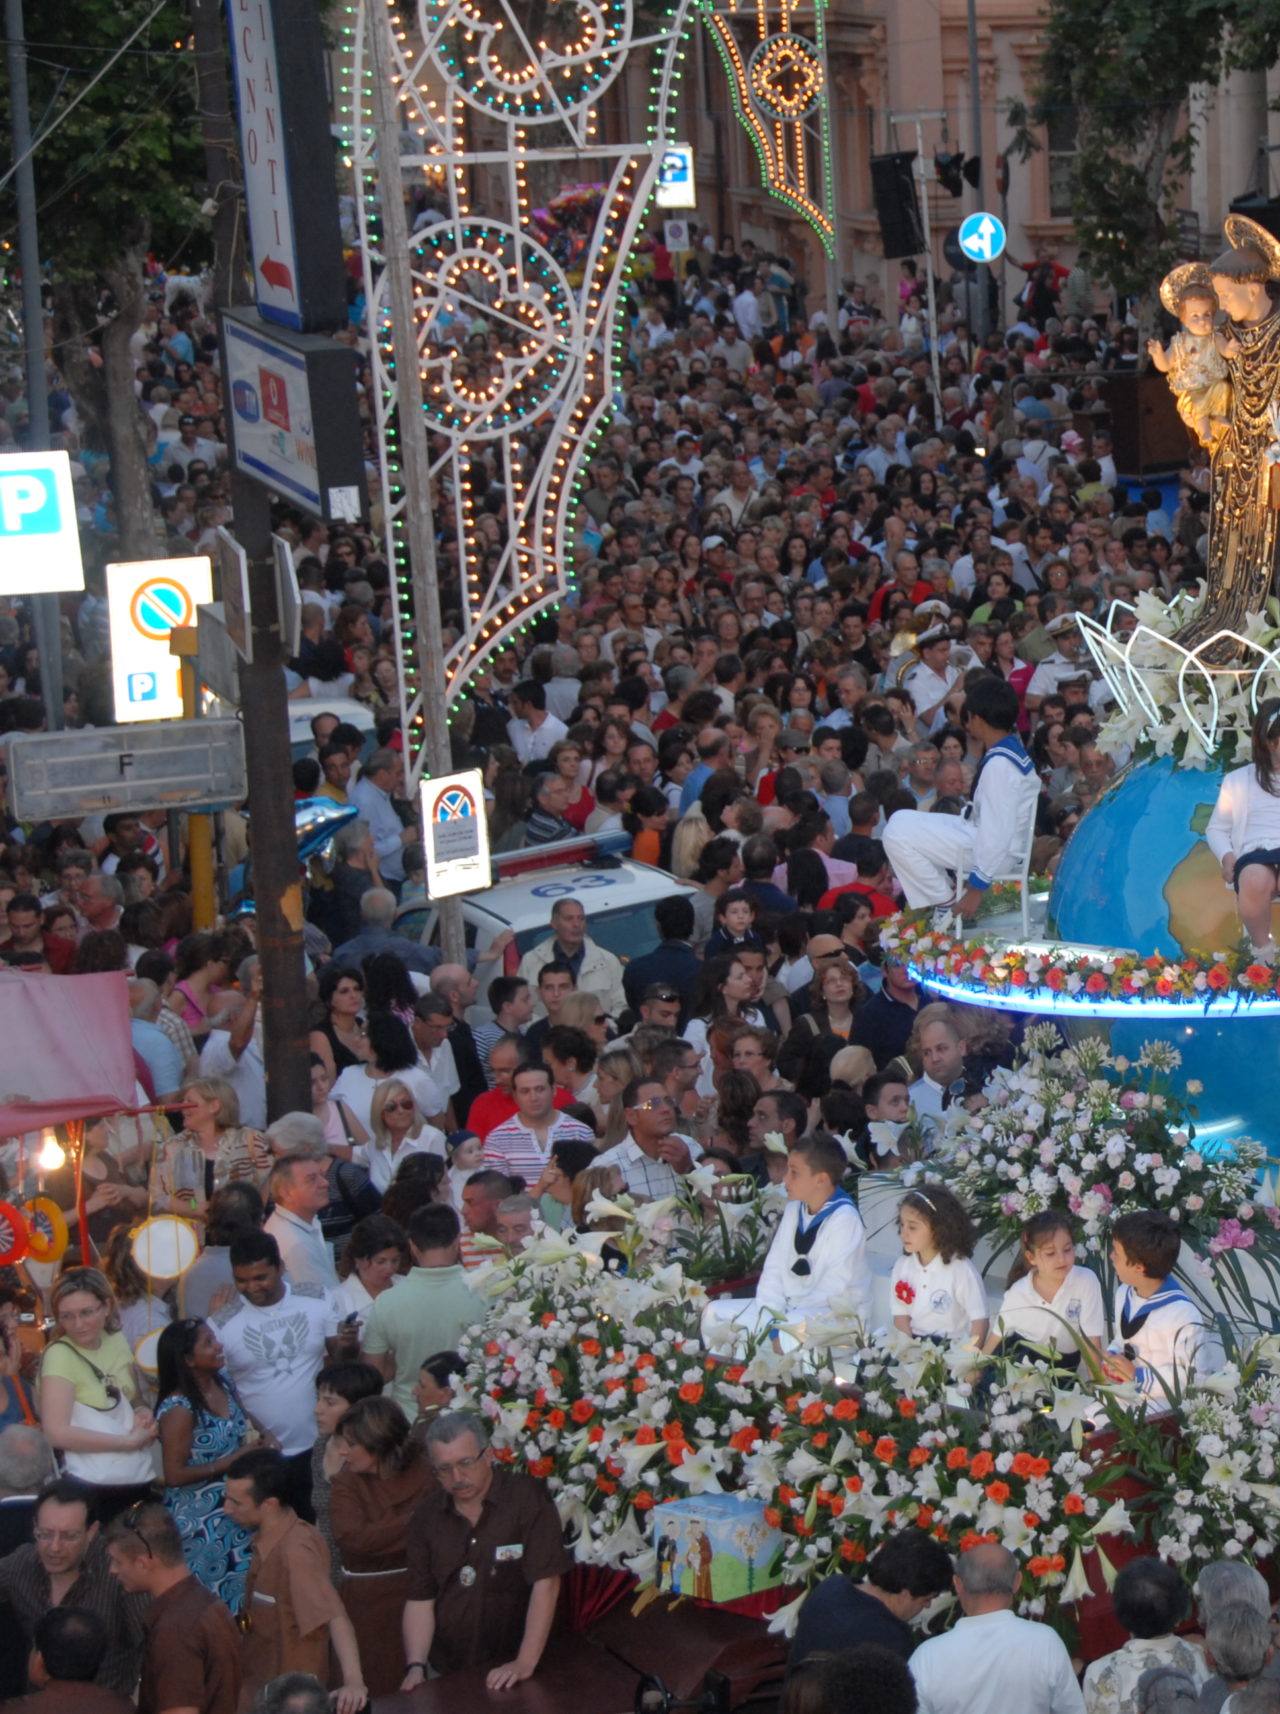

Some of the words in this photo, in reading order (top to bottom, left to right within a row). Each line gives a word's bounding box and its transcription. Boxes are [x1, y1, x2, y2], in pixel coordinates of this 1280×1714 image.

[663, 156, 684, 181] P
[0, 474, 48, 532] P
[132, 673, 155, 701] P
[118, 754, 134, 775] F
[530, 874, 617, 898] 63
